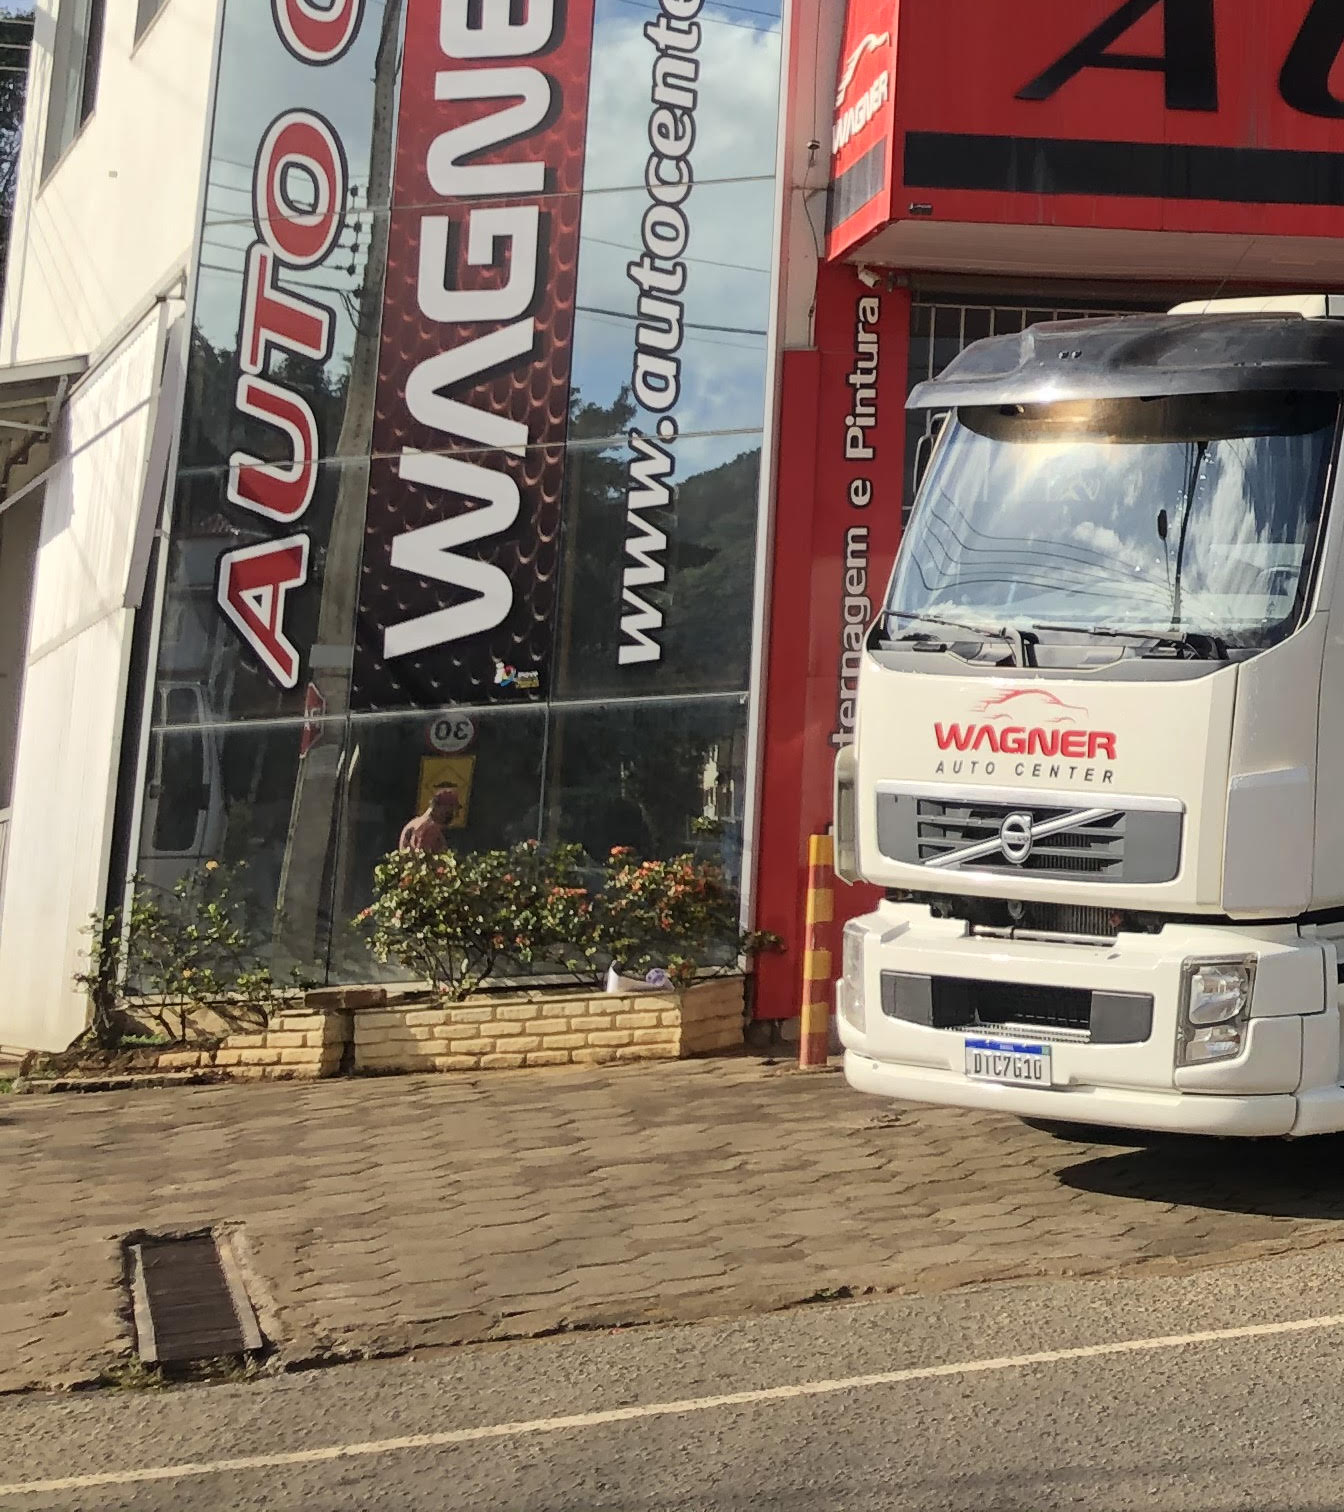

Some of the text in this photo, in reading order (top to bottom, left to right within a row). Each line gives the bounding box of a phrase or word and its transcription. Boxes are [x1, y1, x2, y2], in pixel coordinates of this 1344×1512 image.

[217, 108, 348, 688] AUTO
[831, 296, 880, 748] ternagem e Pintura
[934, 722, 1117, 760] WAGNER
[935, 760, 1115, 783] AUTO CENTER
